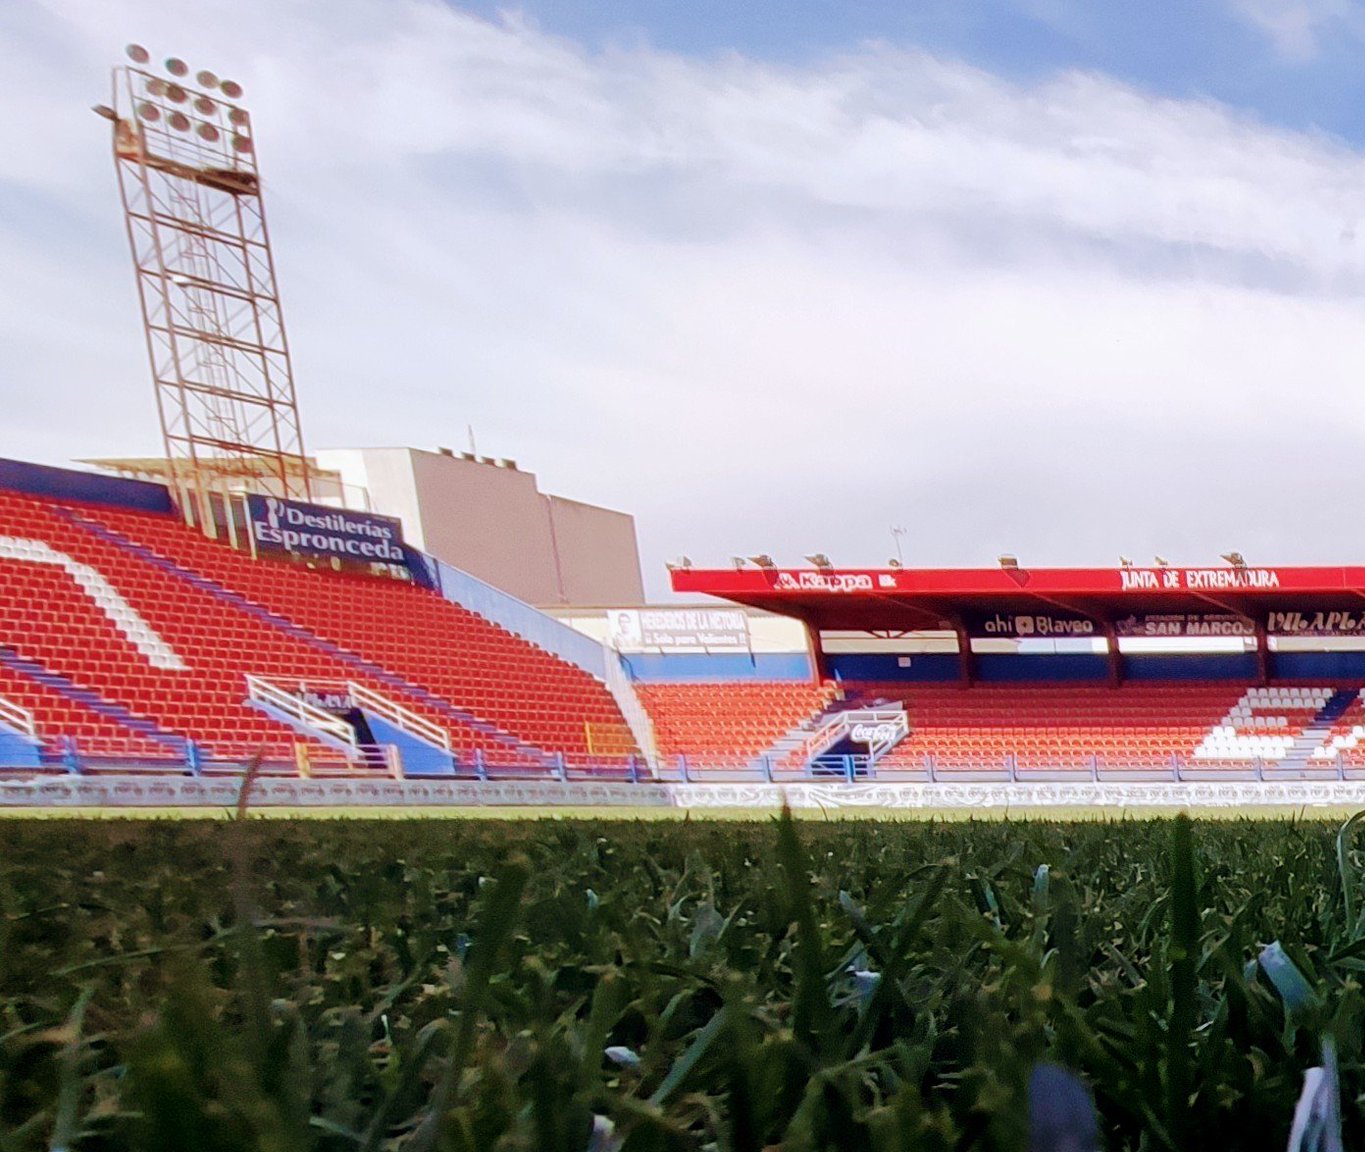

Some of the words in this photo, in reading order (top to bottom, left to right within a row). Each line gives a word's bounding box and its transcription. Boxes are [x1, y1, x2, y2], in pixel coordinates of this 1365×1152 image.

[286, 508, 392, 540] Destilerías
[254, 521, 405, 561] Espronceda
[799, 572, 873, 592] Kappa
[1120, 570, 1159, 590] JUNTA
[1163, 571, 1180, 588] DE
[1186, 570, 1279, 588] EXTREMADURA
[1145, 621, 1181, 636] SAN
